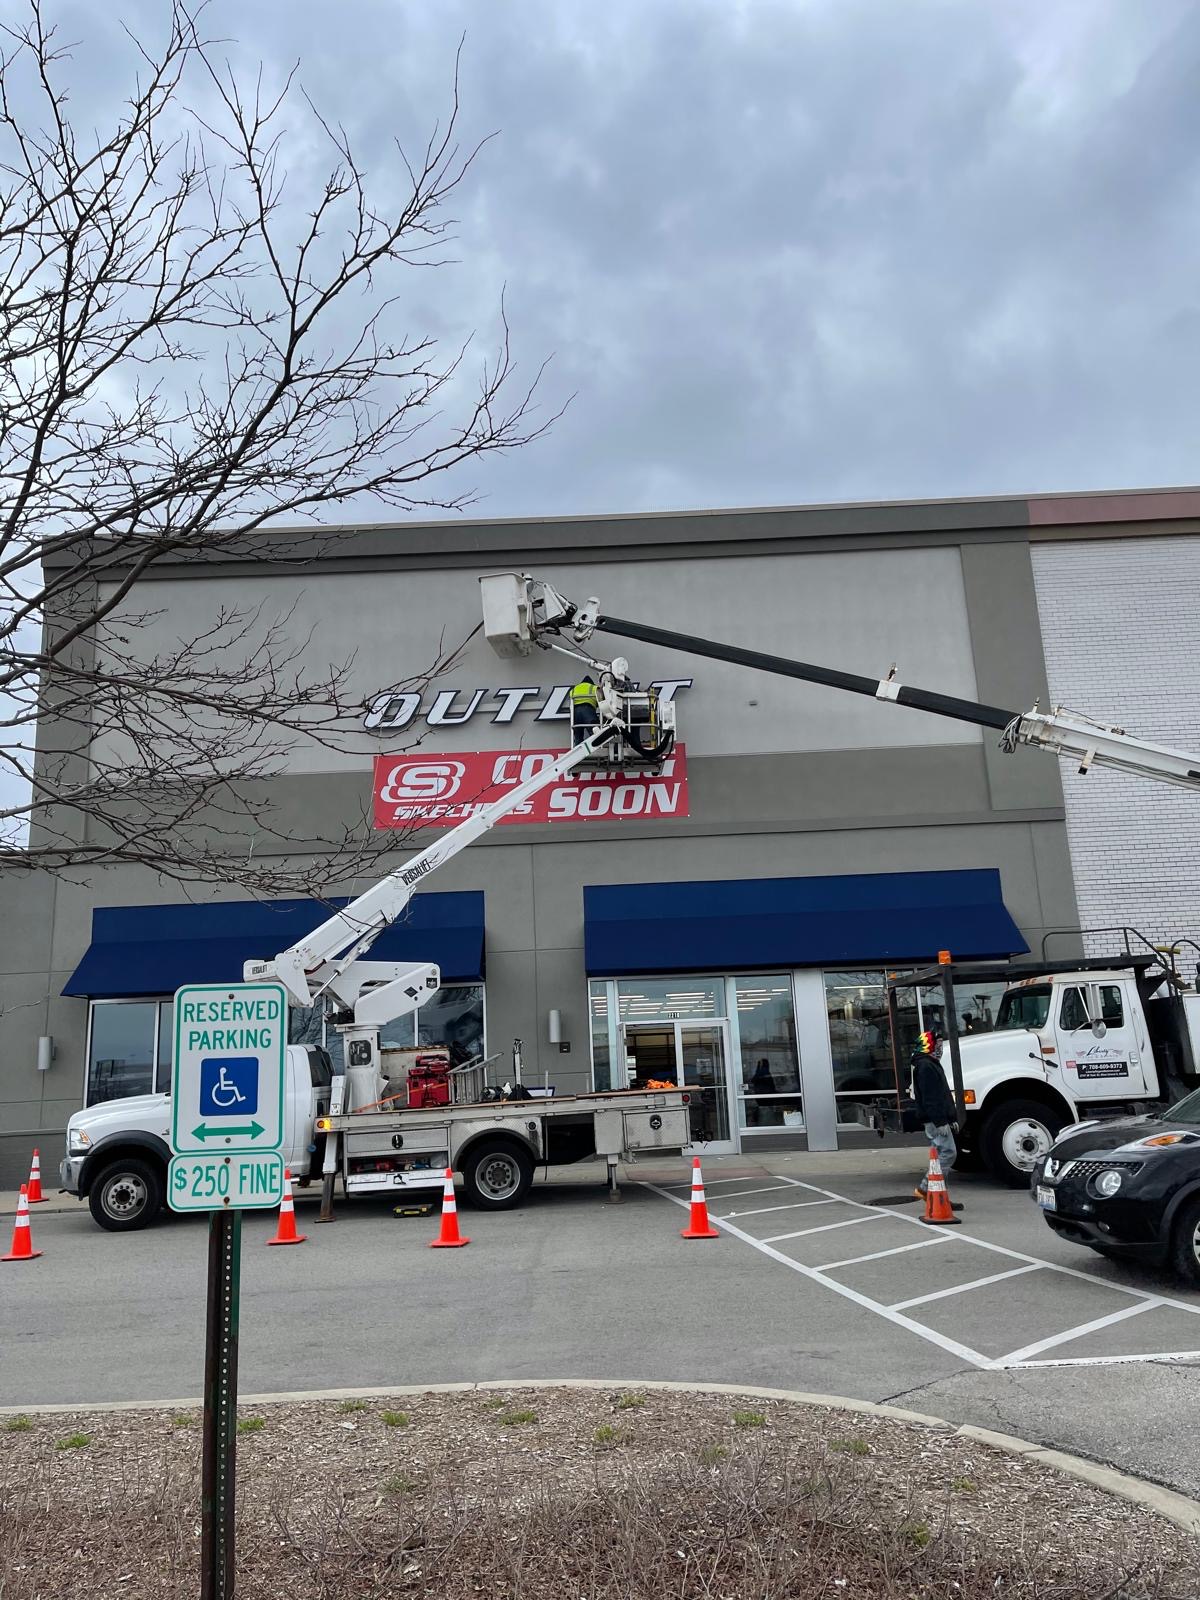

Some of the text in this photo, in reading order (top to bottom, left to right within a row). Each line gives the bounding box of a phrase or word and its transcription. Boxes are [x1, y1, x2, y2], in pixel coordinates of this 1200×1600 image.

[363, 678, 694, 729] OUTLT
[547, 782, 682, 818] SOON
[402, 858, 431, 886] VERSALIFT
[183, 1000, 279, 1023] RESERVED
[188, 1028, 272, 1051] PARKING
[239, 1162, 280, 1194] FINE
